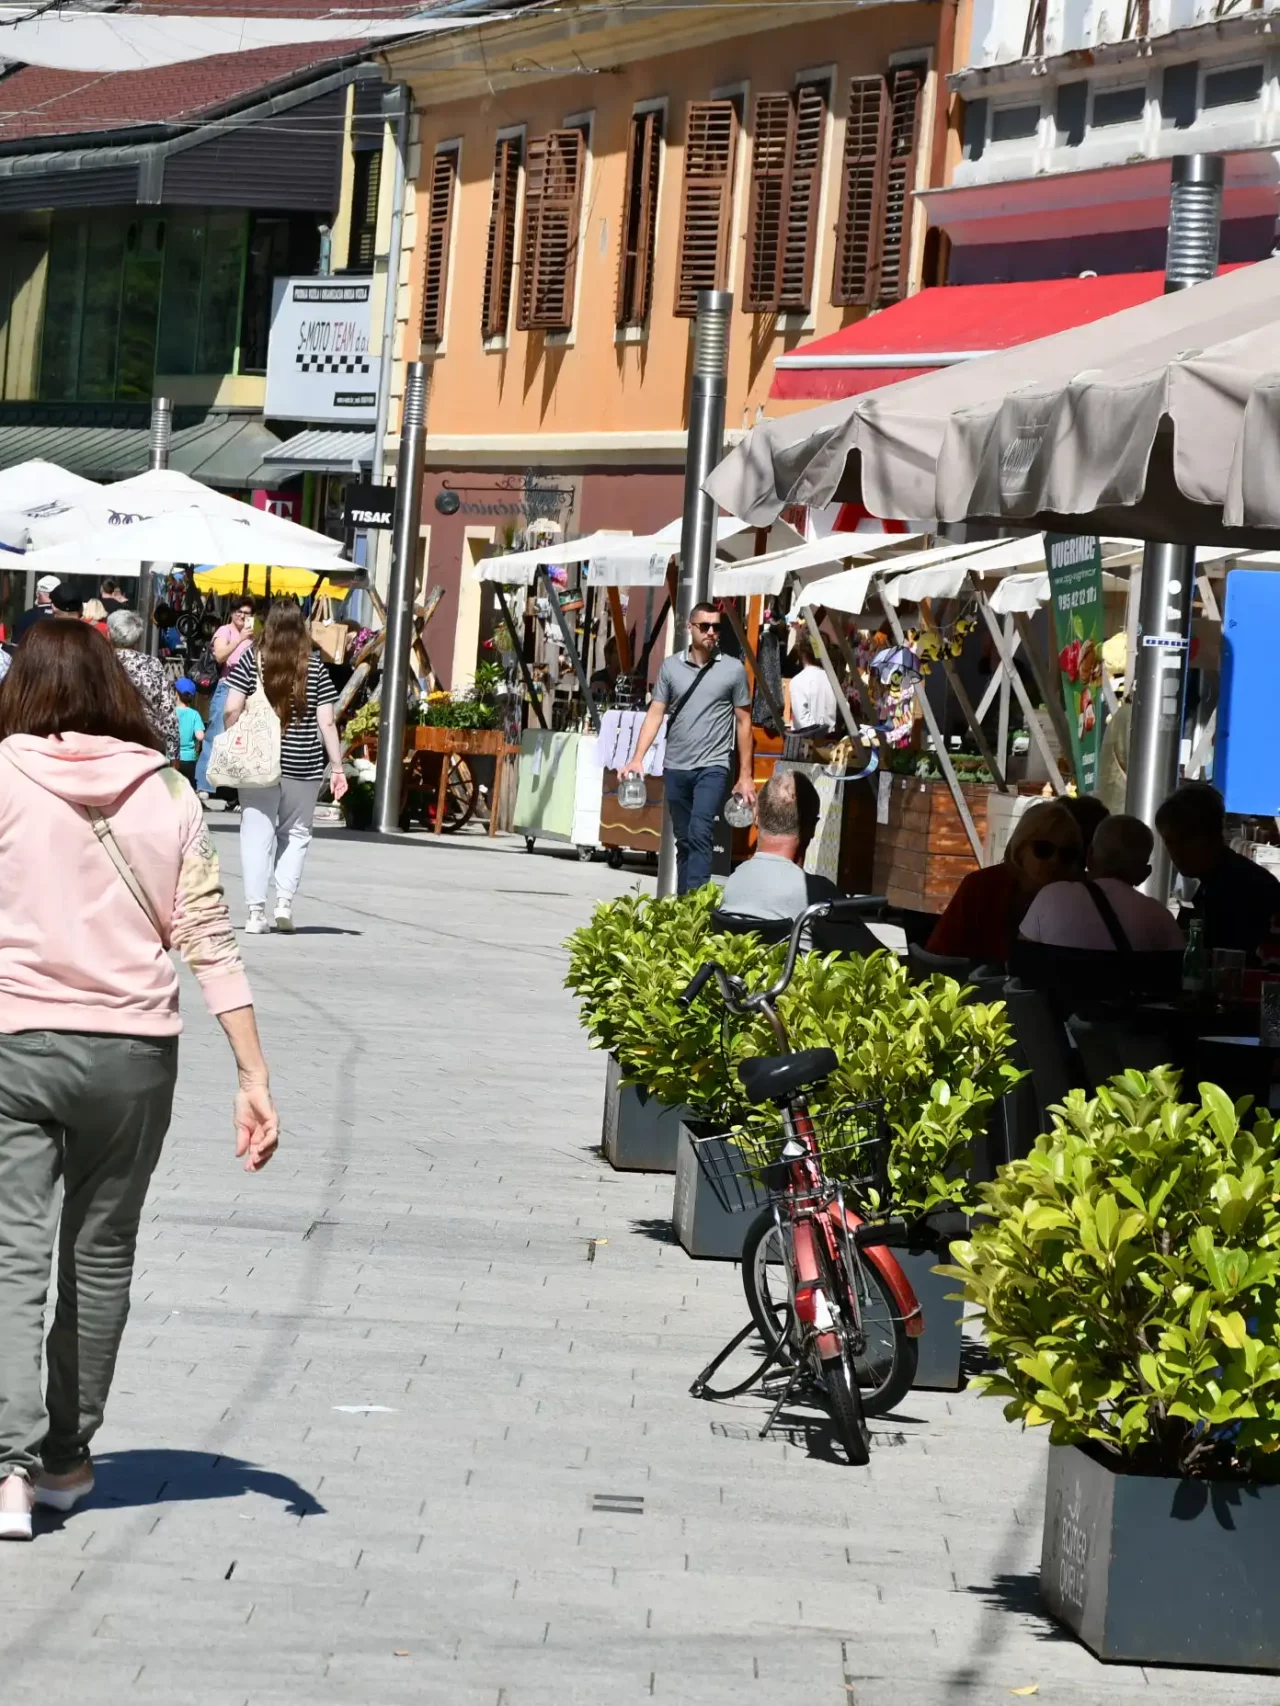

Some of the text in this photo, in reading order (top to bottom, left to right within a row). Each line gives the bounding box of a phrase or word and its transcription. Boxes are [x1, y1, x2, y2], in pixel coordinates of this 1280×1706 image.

[297, 321, 331, 351] S-MOTO
[331, 321, 356, 351] TEAM
[351, 509, 391, 524] TISAK
